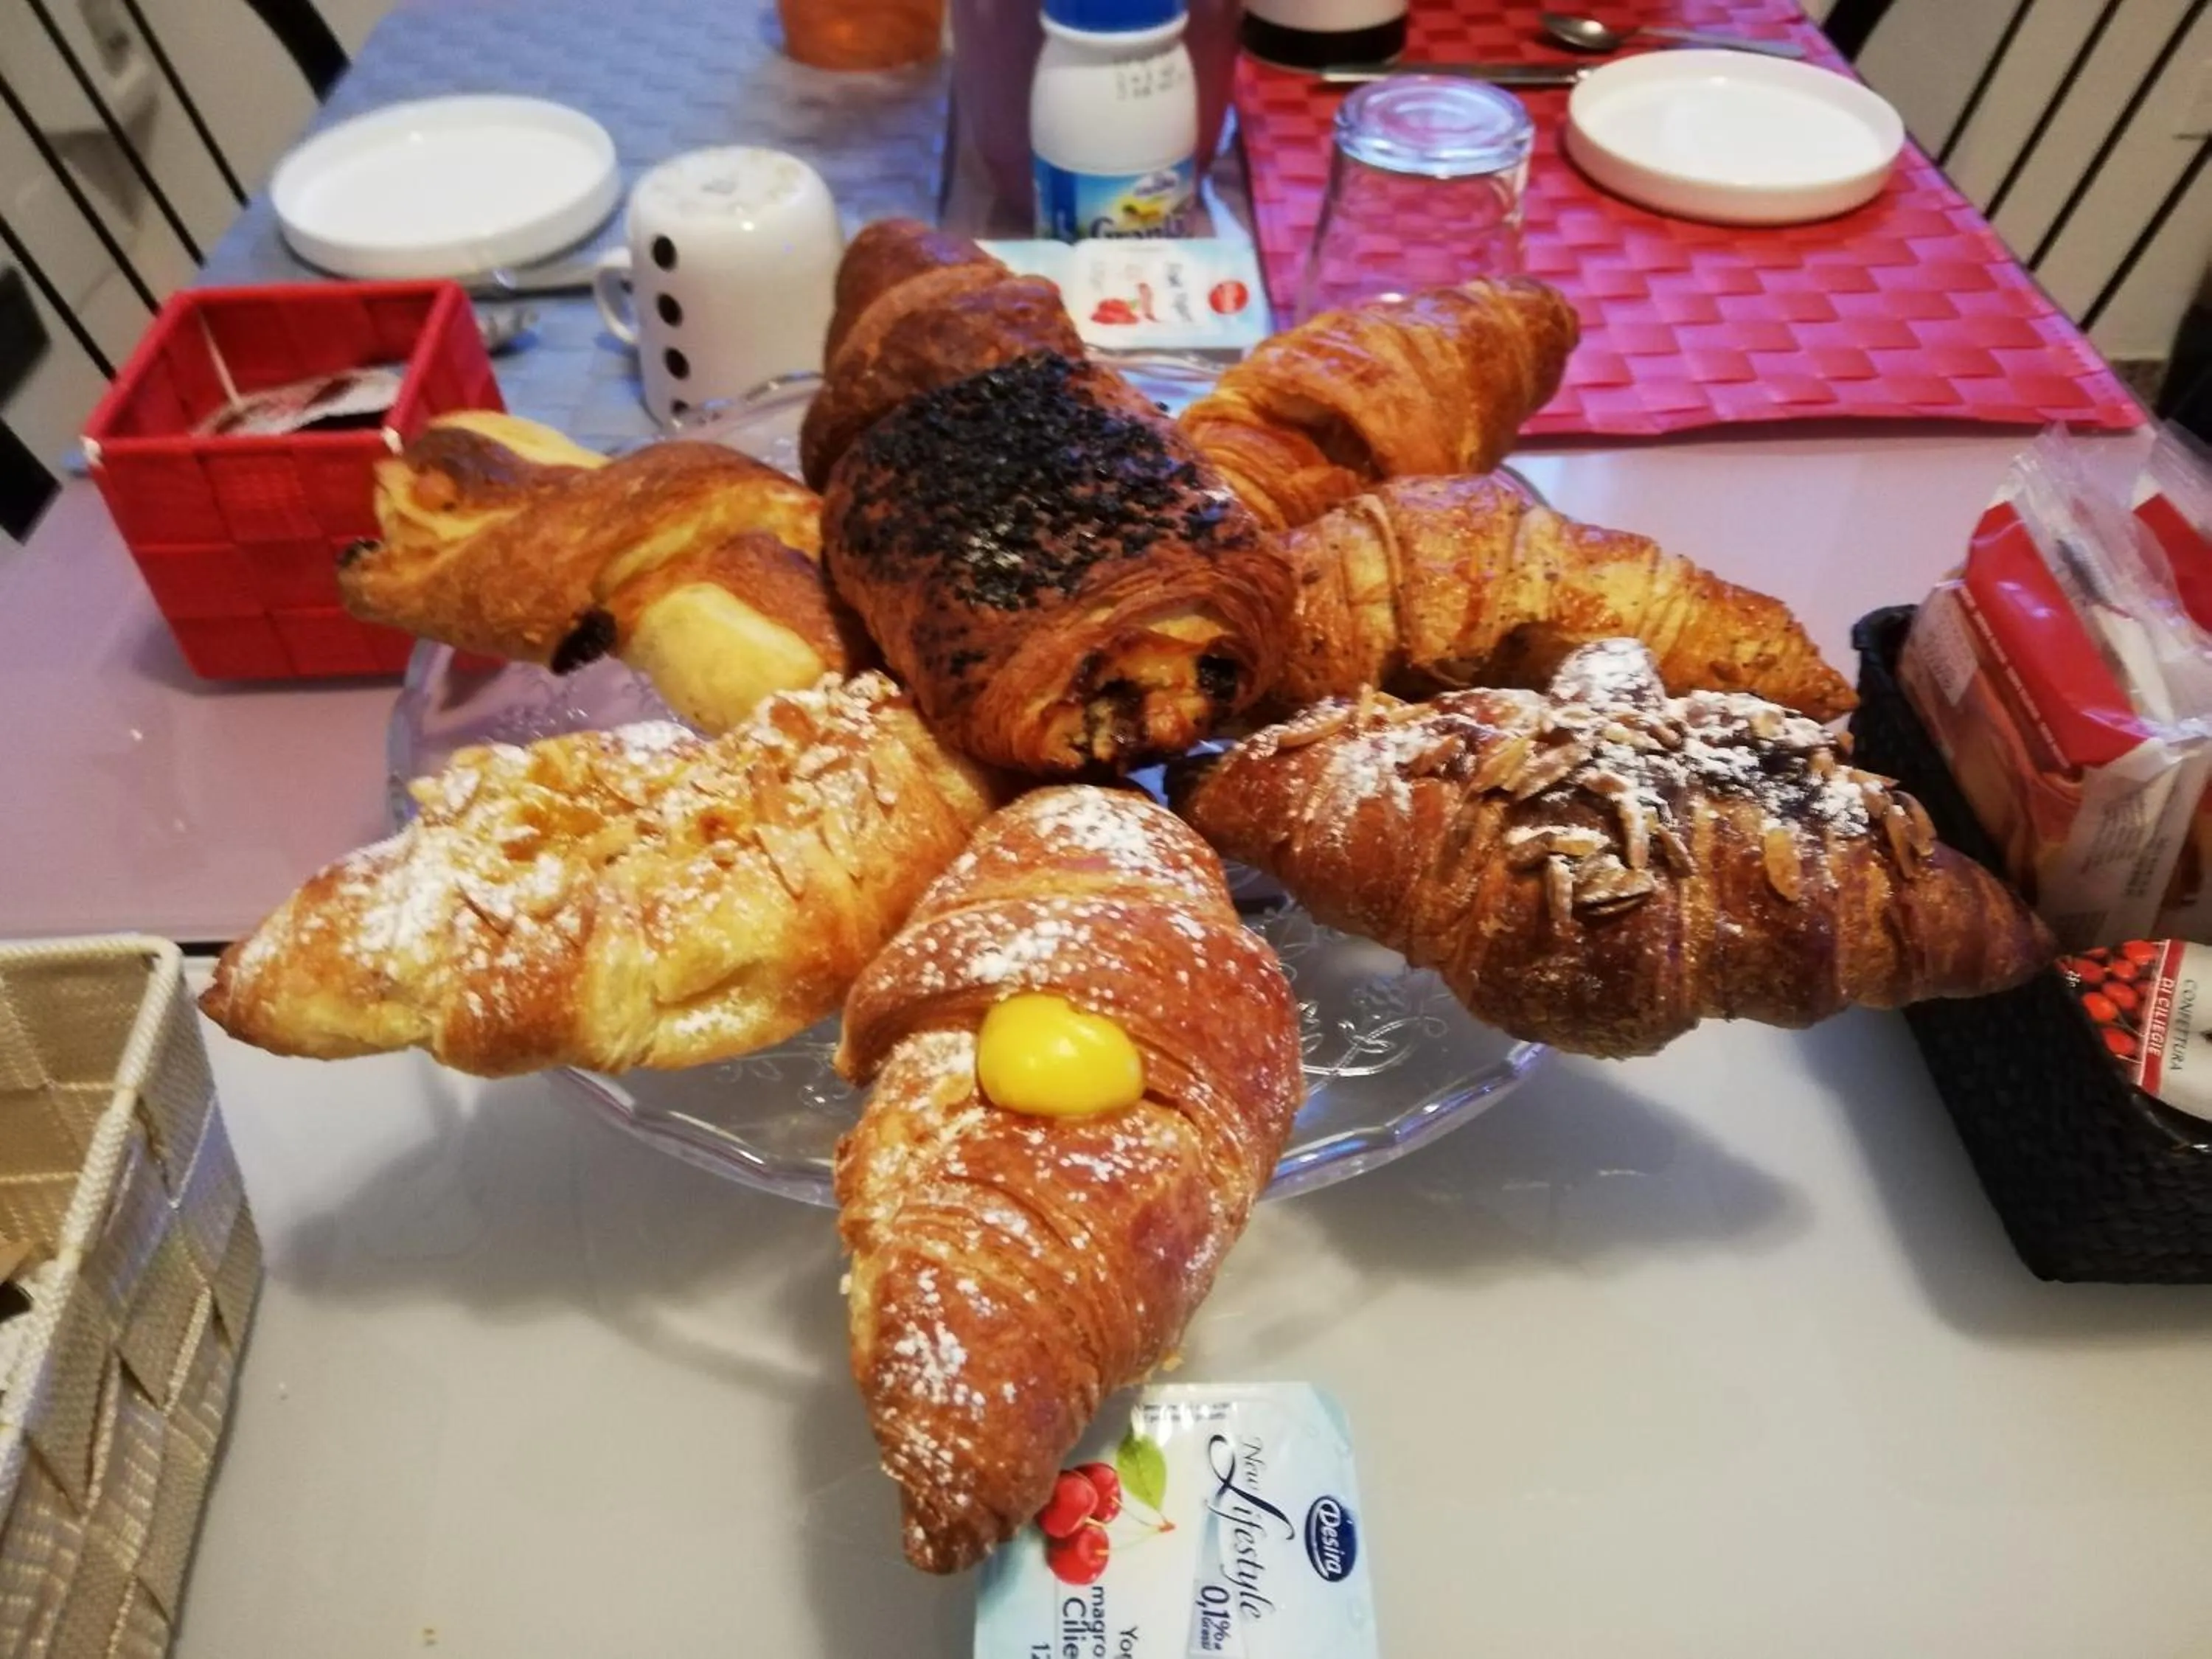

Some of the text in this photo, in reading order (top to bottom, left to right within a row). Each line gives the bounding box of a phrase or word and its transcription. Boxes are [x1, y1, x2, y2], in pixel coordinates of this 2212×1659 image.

[2148, 977, 2175, 1055] DI CILIEGIE
[2170, 979, 2197, 1070] CONFETTURA
[1204, 1434, 1295, 1621] New Lifestyle
[1315, 1498, 1346, 1575] Desira
[1062, 1597, 1087, 1659] Cilie
[1083, 1586, 1105, 1658] magro
[1195, 1585, 1231, 1639] 0,1%
